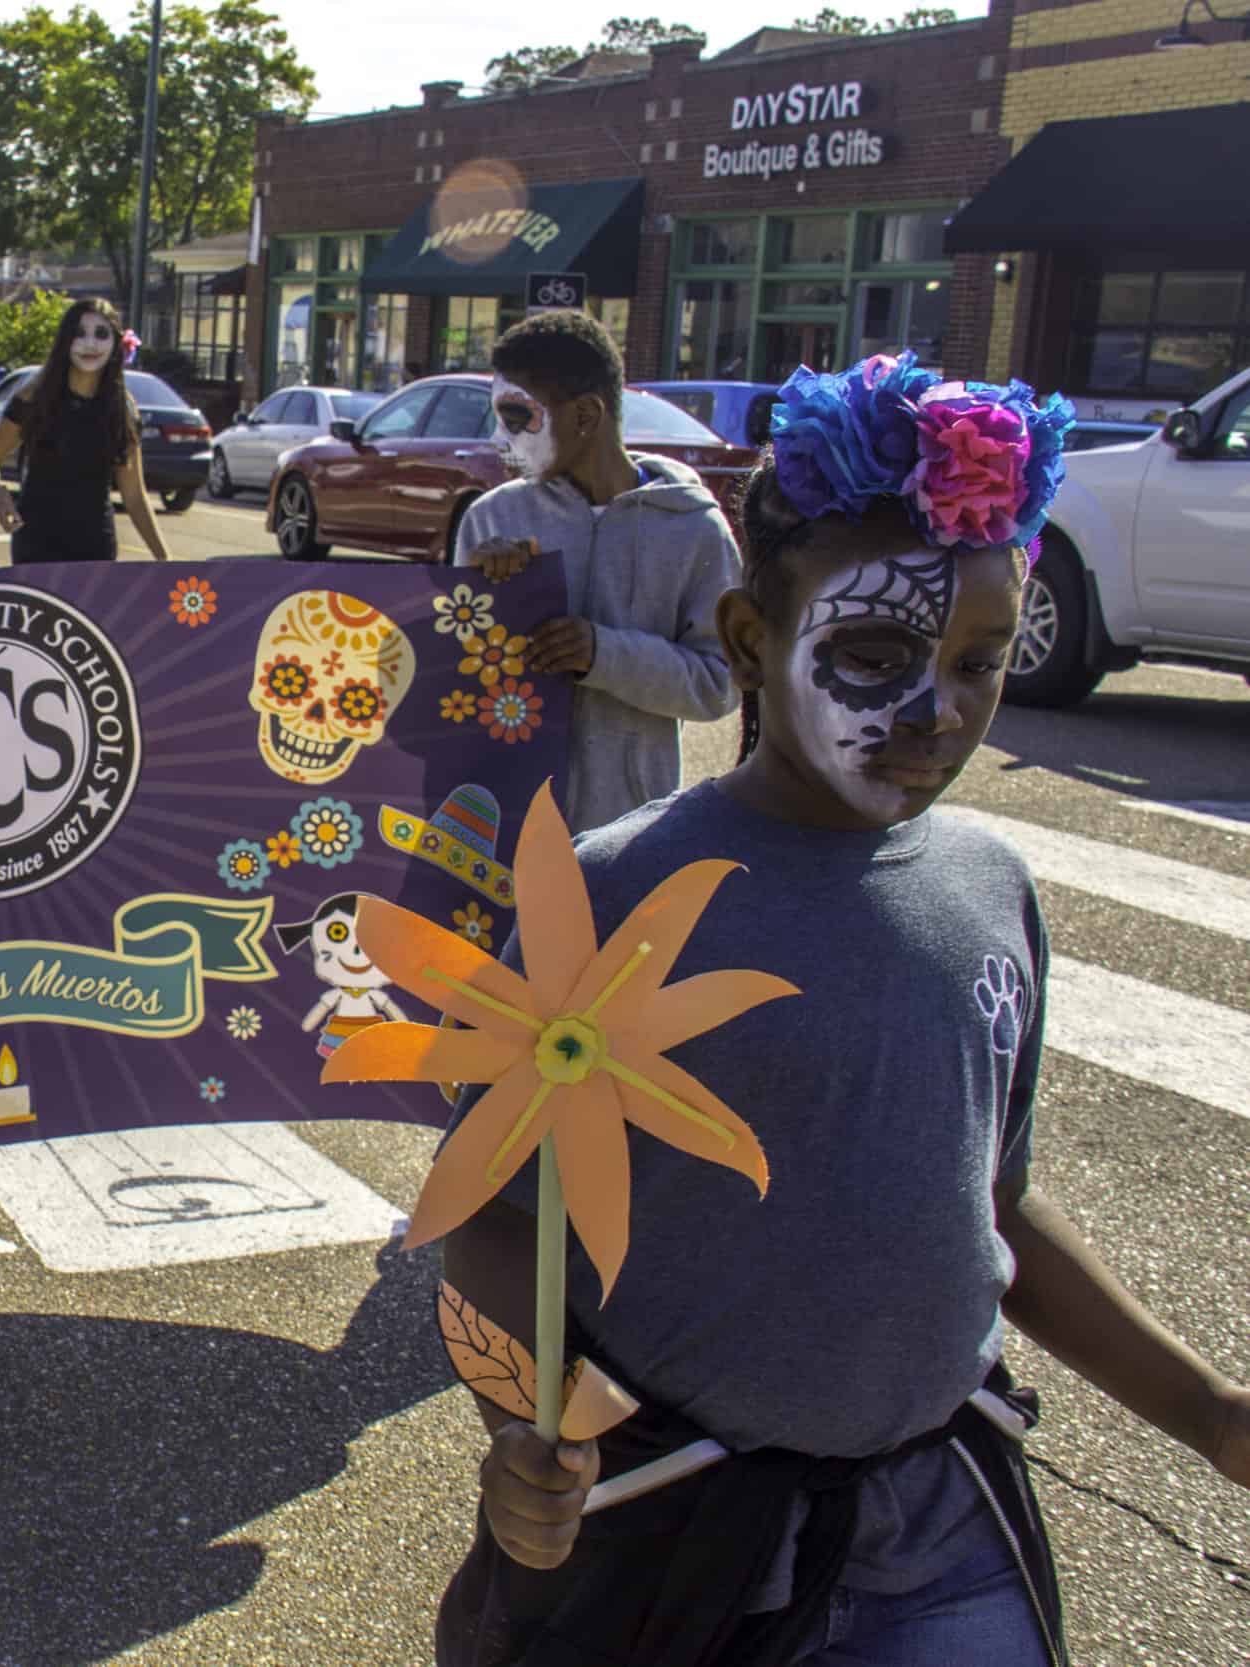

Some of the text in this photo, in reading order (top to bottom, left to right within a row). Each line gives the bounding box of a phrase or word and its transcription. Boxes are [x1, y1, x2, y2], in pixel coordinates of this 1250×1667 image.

[703, 128, 883, 181] Boutique & Gifts
[417, 208, 561, 257] WHATEVER
[43, 618, 125, 785] SCHOOLS
[45, 815, 90, 860] 1867
[18, 959, 164, 1017] Muertos
